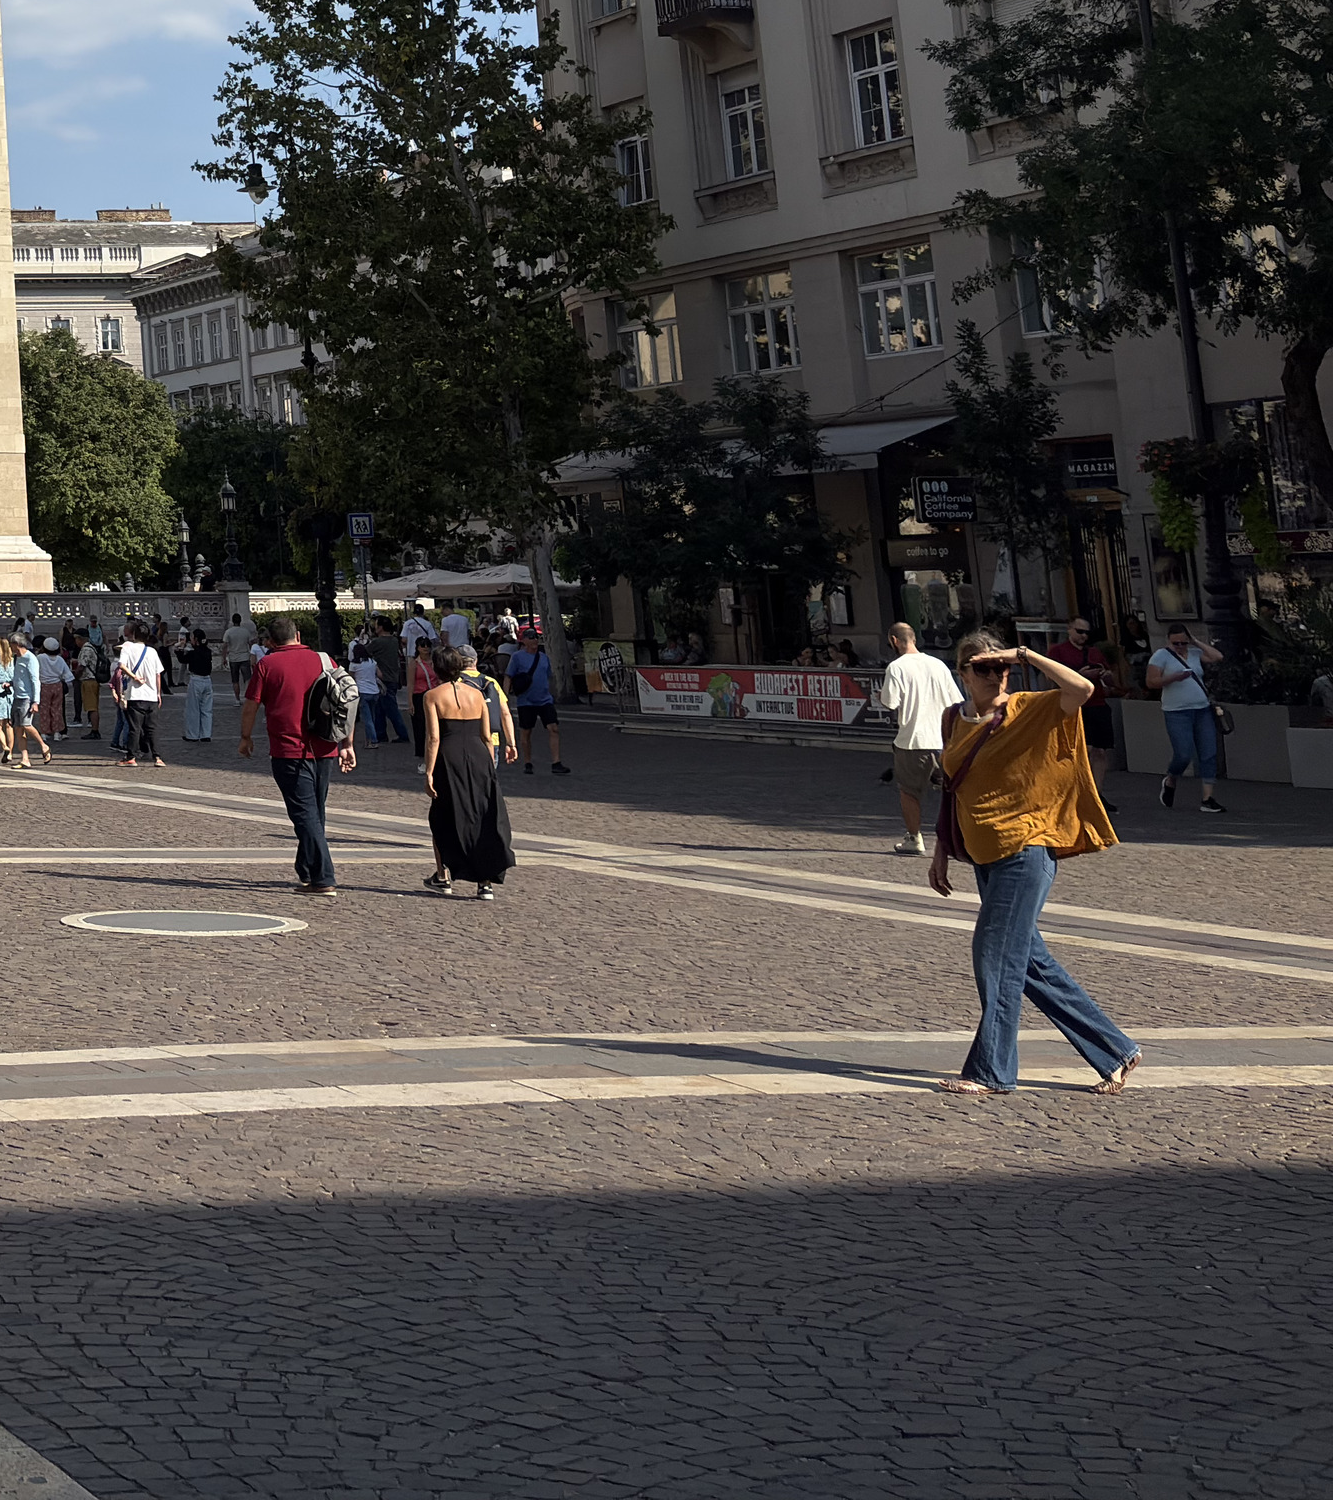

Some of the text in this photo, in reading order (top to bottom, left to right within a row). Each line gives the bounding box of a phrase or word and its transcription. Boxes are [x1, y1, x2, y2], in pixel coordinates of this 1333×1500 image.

[1068, 462, 1115, 473] MAGAZIN
[923, 494, 973, 503] California
[924, 502, 959, 511] Coffee
[925, 510, 974, 520] Company
[906, 546, 949, 558] coffee to go
[754, 673, 841, 697] BUDAPEST RETRO
[755, 698, 843, 722] INTERACTIVE MUSEUM
